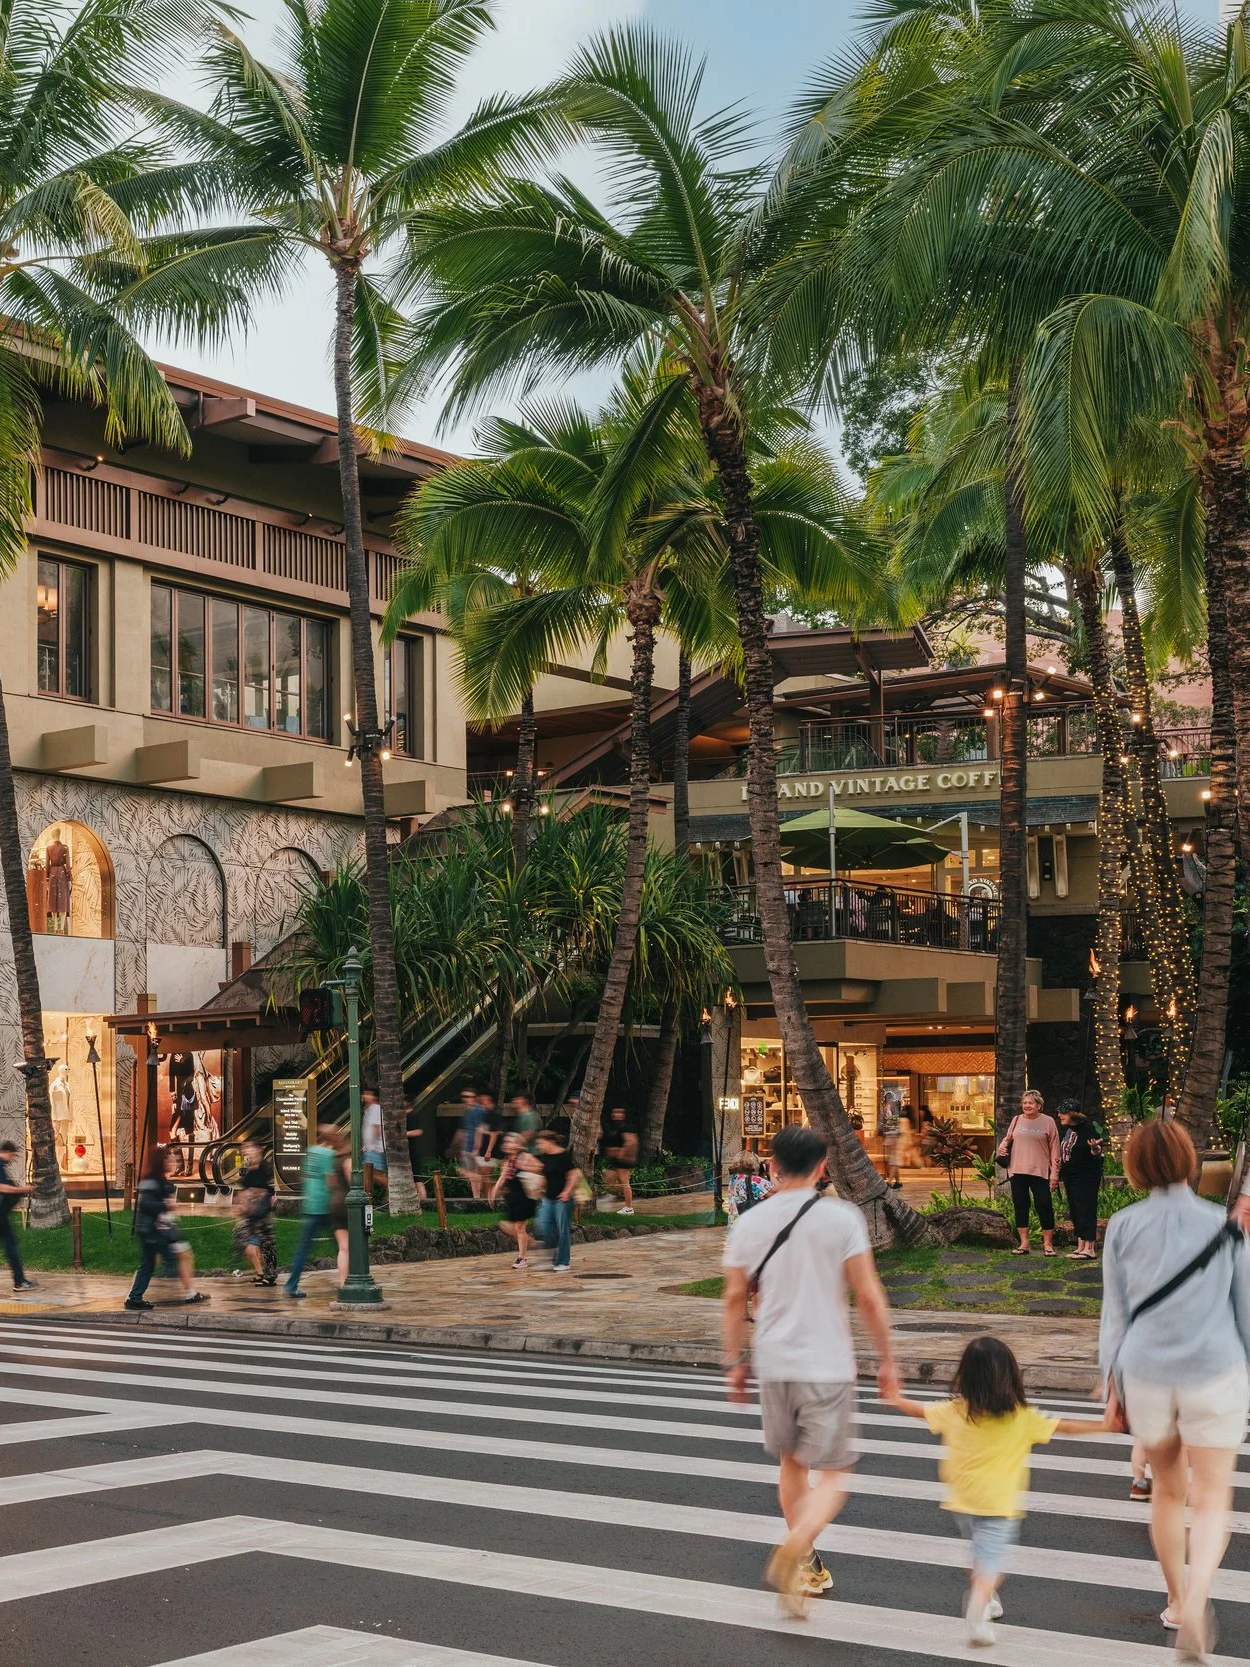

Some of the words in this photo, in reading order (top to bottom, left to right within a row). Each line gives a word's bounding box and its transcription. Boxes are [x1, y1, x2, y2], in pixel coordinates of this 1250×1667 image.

[741, 781, 825, 801] IAND
[830, 775, 930, 795] VINTAGE
[937, 770, 1001, 789] COFF
